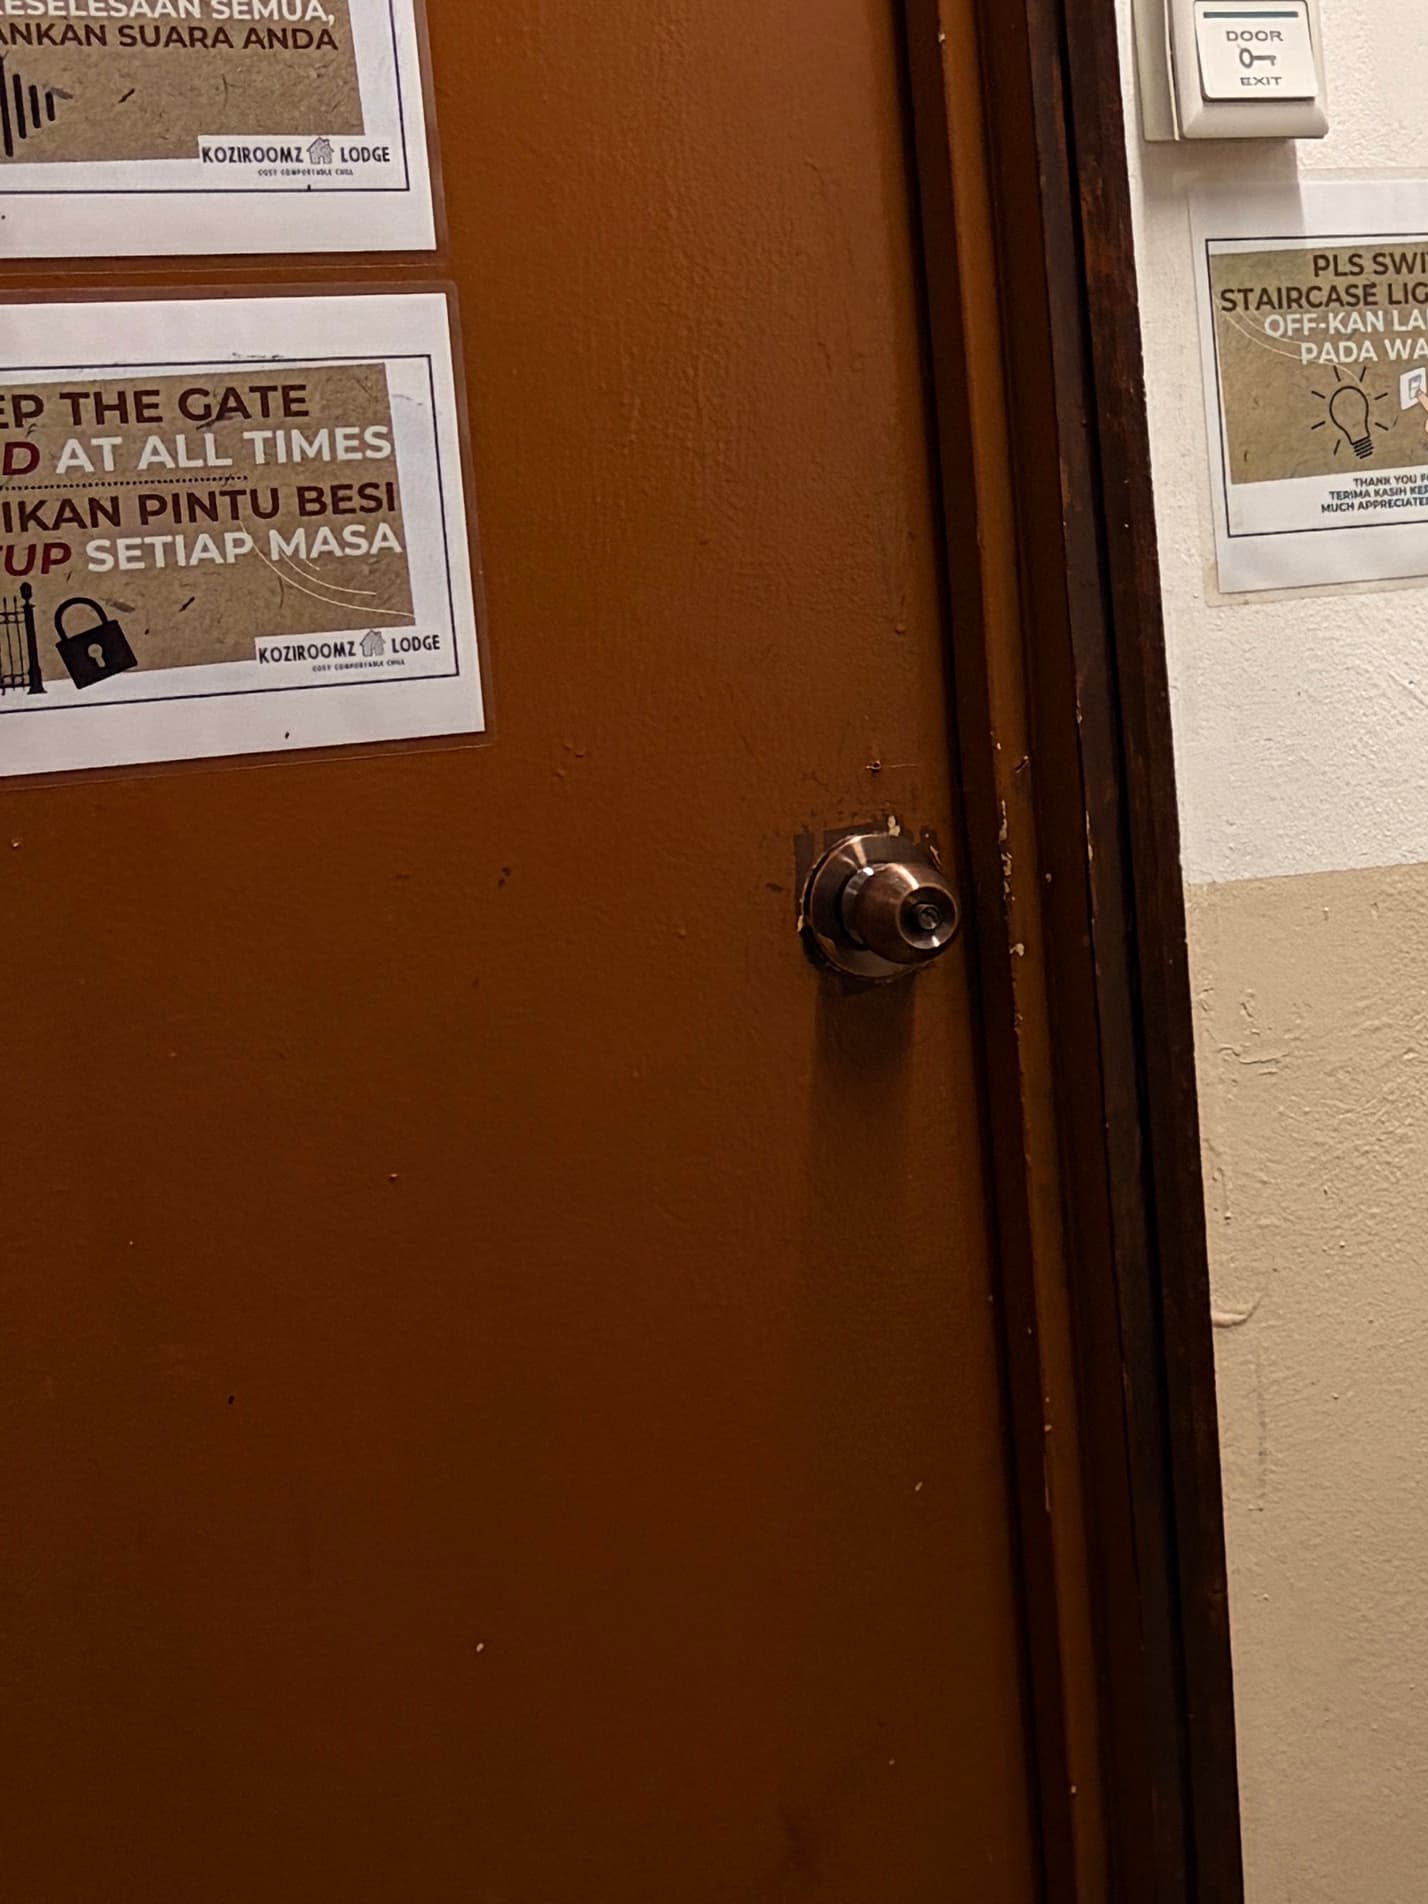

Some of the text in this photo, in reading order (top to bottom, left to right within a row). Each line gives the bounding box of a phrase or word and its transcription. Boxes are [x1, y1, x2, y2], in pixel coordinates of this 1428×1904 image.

[119, 24, 234, 49] SUARA
[243, 27, 338, 51] ANDA
[1226, 30, 1284, 42] DOOR
[1240, 76, 1283, 86] EXIT
[202, 146, 390, 163] KOZIROOMZ LODGE
[1313, 252, 1364, 278] PLS
[1221, 284, 1377, 312] STAIRCASE
[1264, 311, 1384, 339] OFF-KAN
[1301, 340, 1378, 365] PADA
[59, 389, 164, 426] THE
[178, 385, 310, 422] GATE
[56, 436, 123, 474] AT
[138, 433, 233, 470] ALL
[243, 425, 392, 465] TIMES
[1329, 490, 1370, 501] TERIMA
[1374, 487, 1407, 498] KASIH
[1353, 477, 1391, 487] THANK
[1393, 475, 1417, 484] YOU
[139, 487, 281, 525] PINTU
[296, 481, 396, 517] BESI
[1321, 502, 1354, 513] MUCH
[0, 522, 403, 577] UP SETIAP MASA
[258, 634, 441, 664] KOZIROOMZ LODGE
